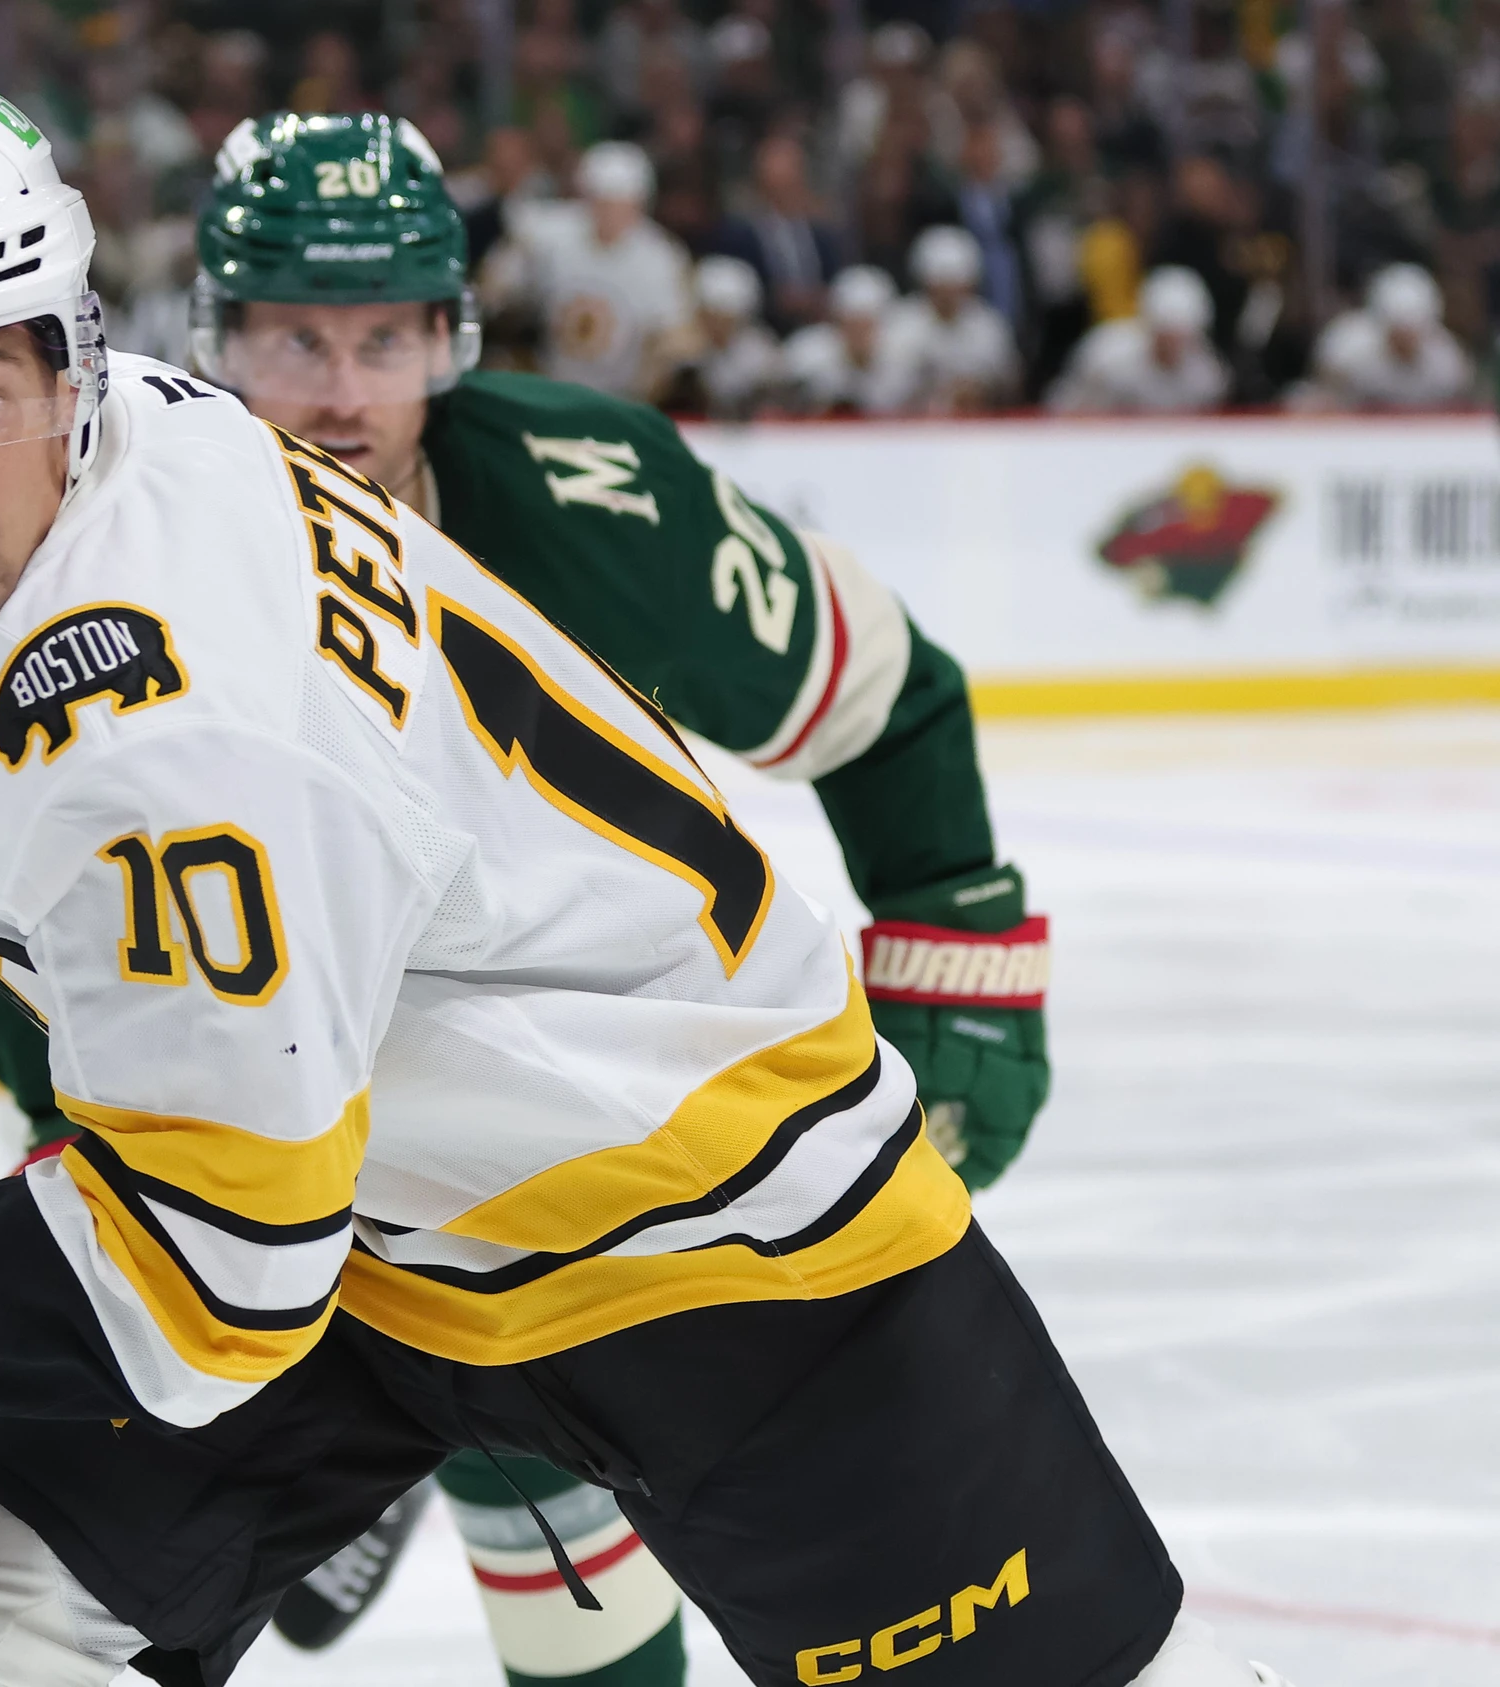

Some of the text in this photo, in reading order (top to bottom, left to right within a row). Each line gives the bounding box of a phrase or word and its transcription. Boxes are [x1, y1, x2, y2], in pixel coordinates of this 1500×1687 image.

[314, 160, 380, 198] 20
[523, 430, 660, 527] M
[711, 470, 800, 656] 20
[9, 618, 142, 709] BOSTON
[95, 821, 291, 1007] 10
[795, 1547, 1030, 1687] CCM
